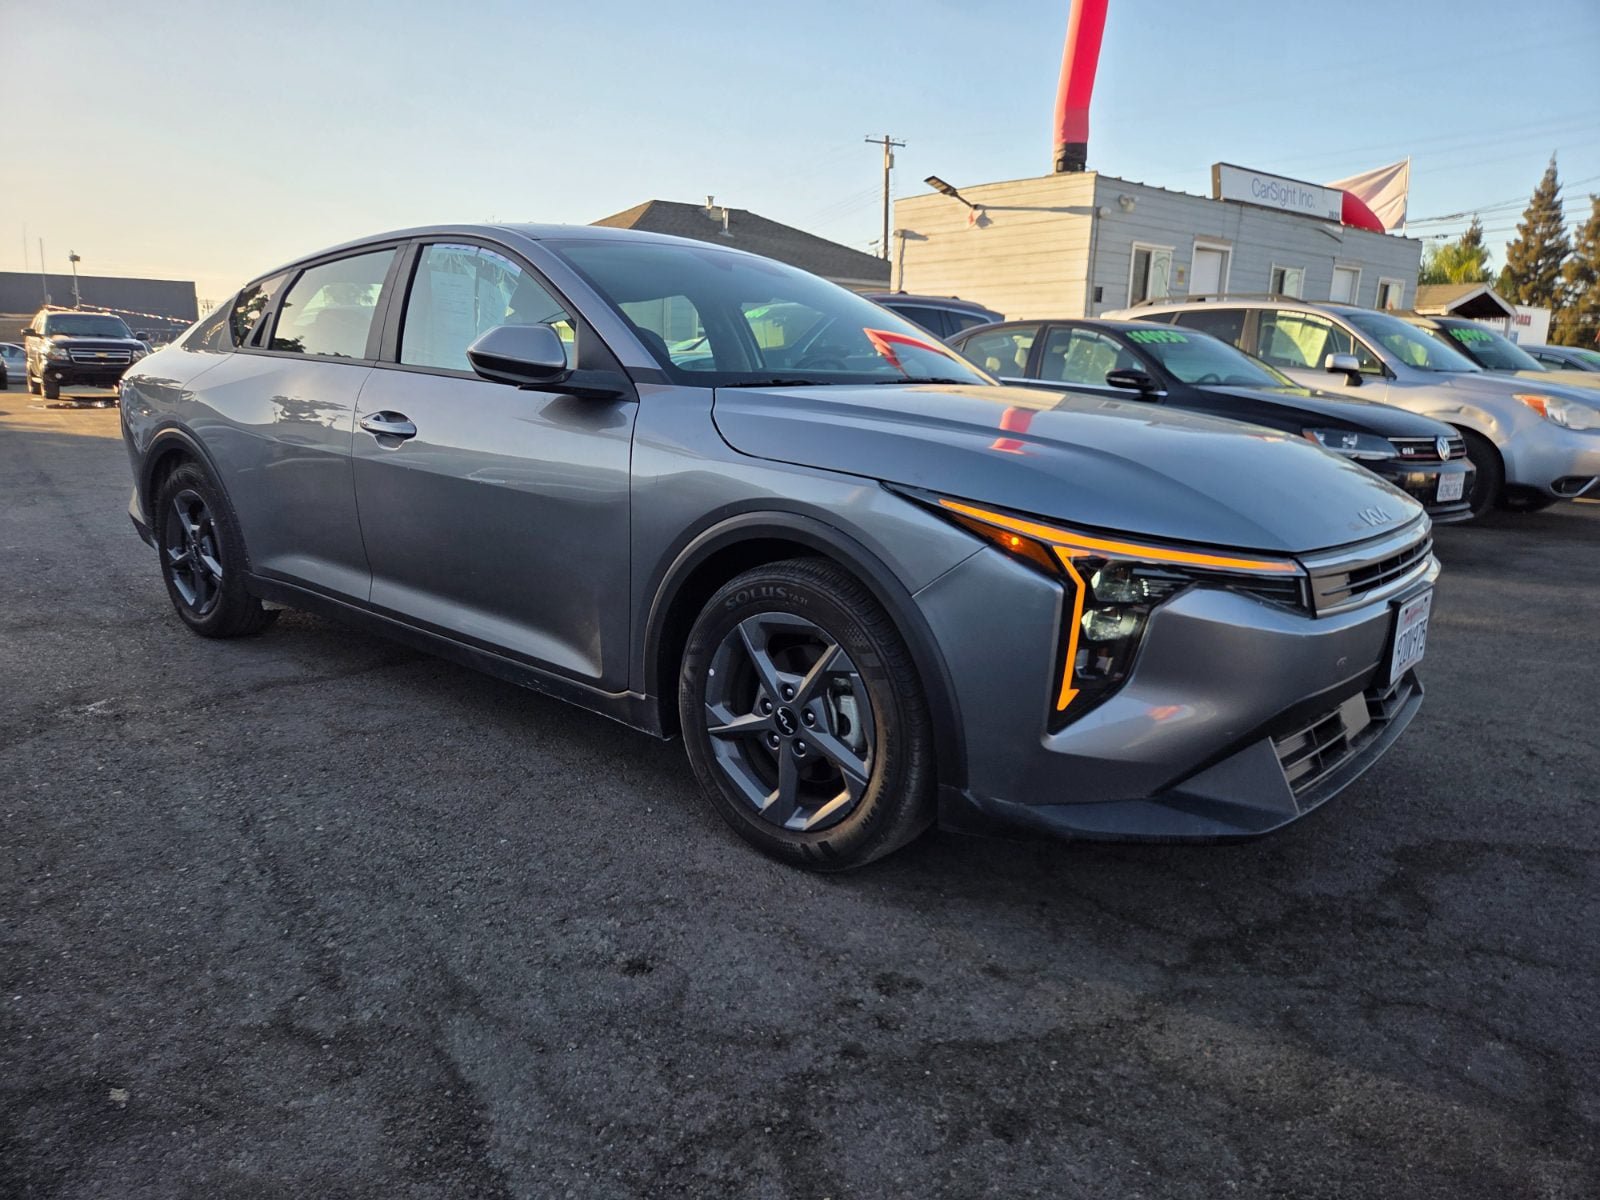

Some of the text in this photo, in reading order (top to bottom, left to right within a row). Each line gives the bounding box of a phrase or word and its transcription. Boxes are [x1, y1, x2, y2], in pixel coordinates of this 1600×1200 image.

[1251, 177, 1316, 209] CarSight Inc.
[725, 586, 787, 610] SOLUS
